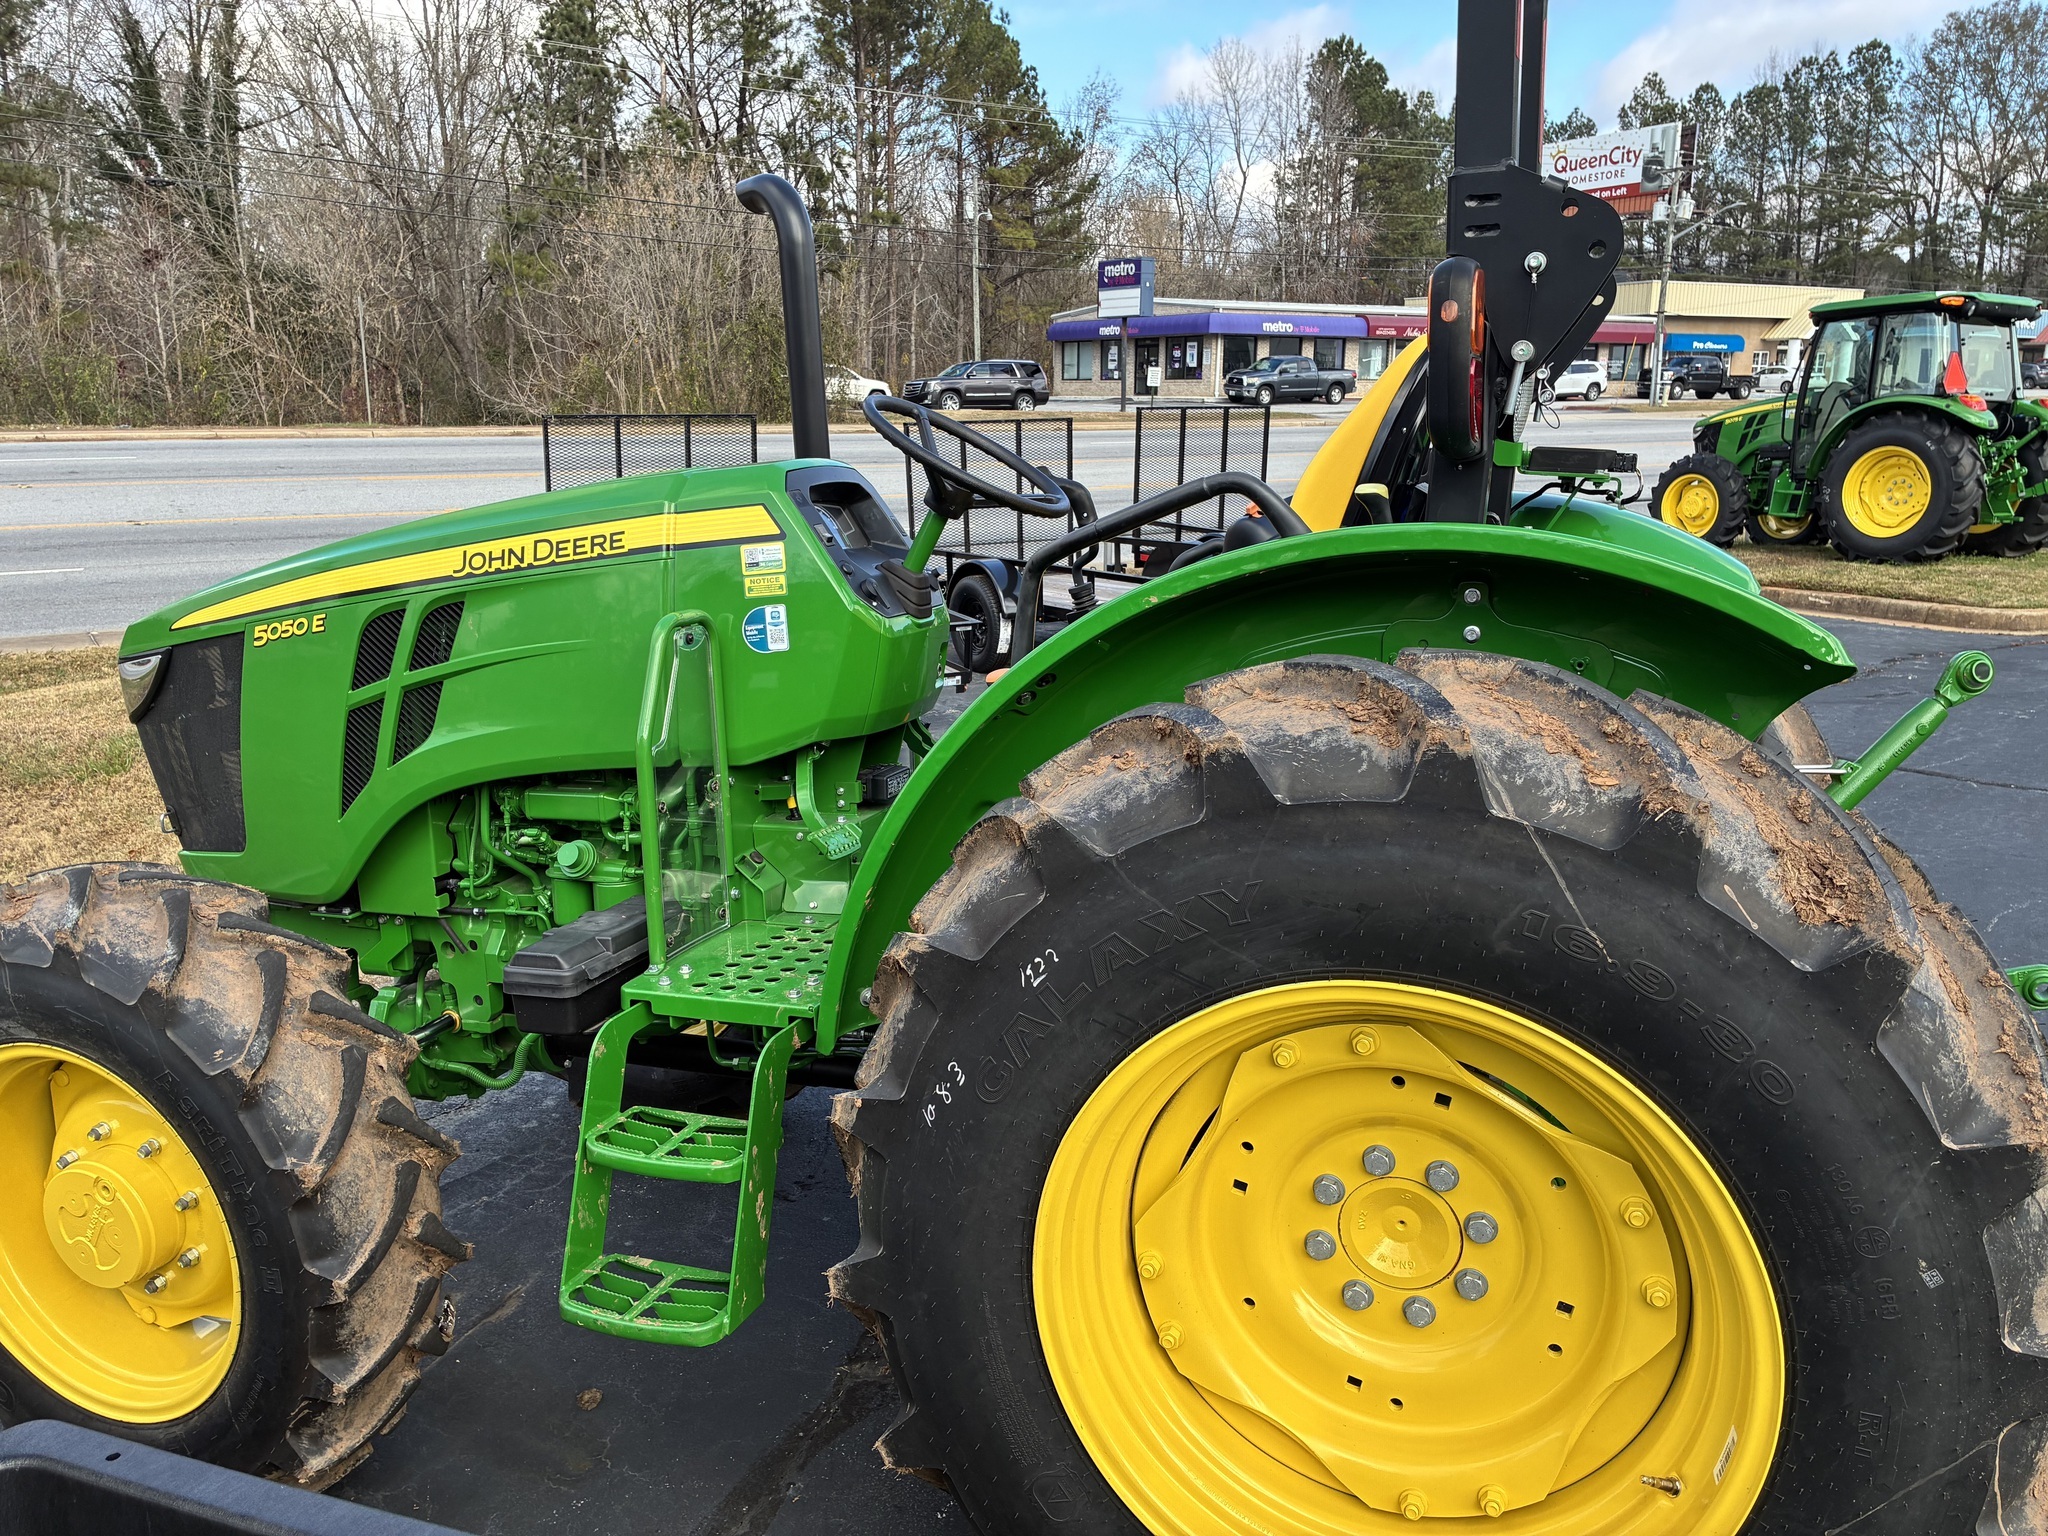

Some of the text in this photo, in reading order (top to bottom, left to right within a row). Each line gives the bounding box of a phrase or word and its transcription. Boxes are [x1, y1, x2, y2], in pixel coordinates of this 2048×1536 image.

[1554, 145, 1642, 173] QueenCity
[1612, 187, 1627, 196] Left
[1104, 261, 1135, 277] metro
[1099, 325, 1120, 335] metro
[1262, 321, 1293, 332] metro
[1692, 341, 1704, 349] Pro
[453, 531, 626, 575] JOHN DEERE
[750, 577, 780, 585] NOTICE
[253, 613, 326, 647] 5050 E
[975, 880, 1263, 1104] GALAXY
